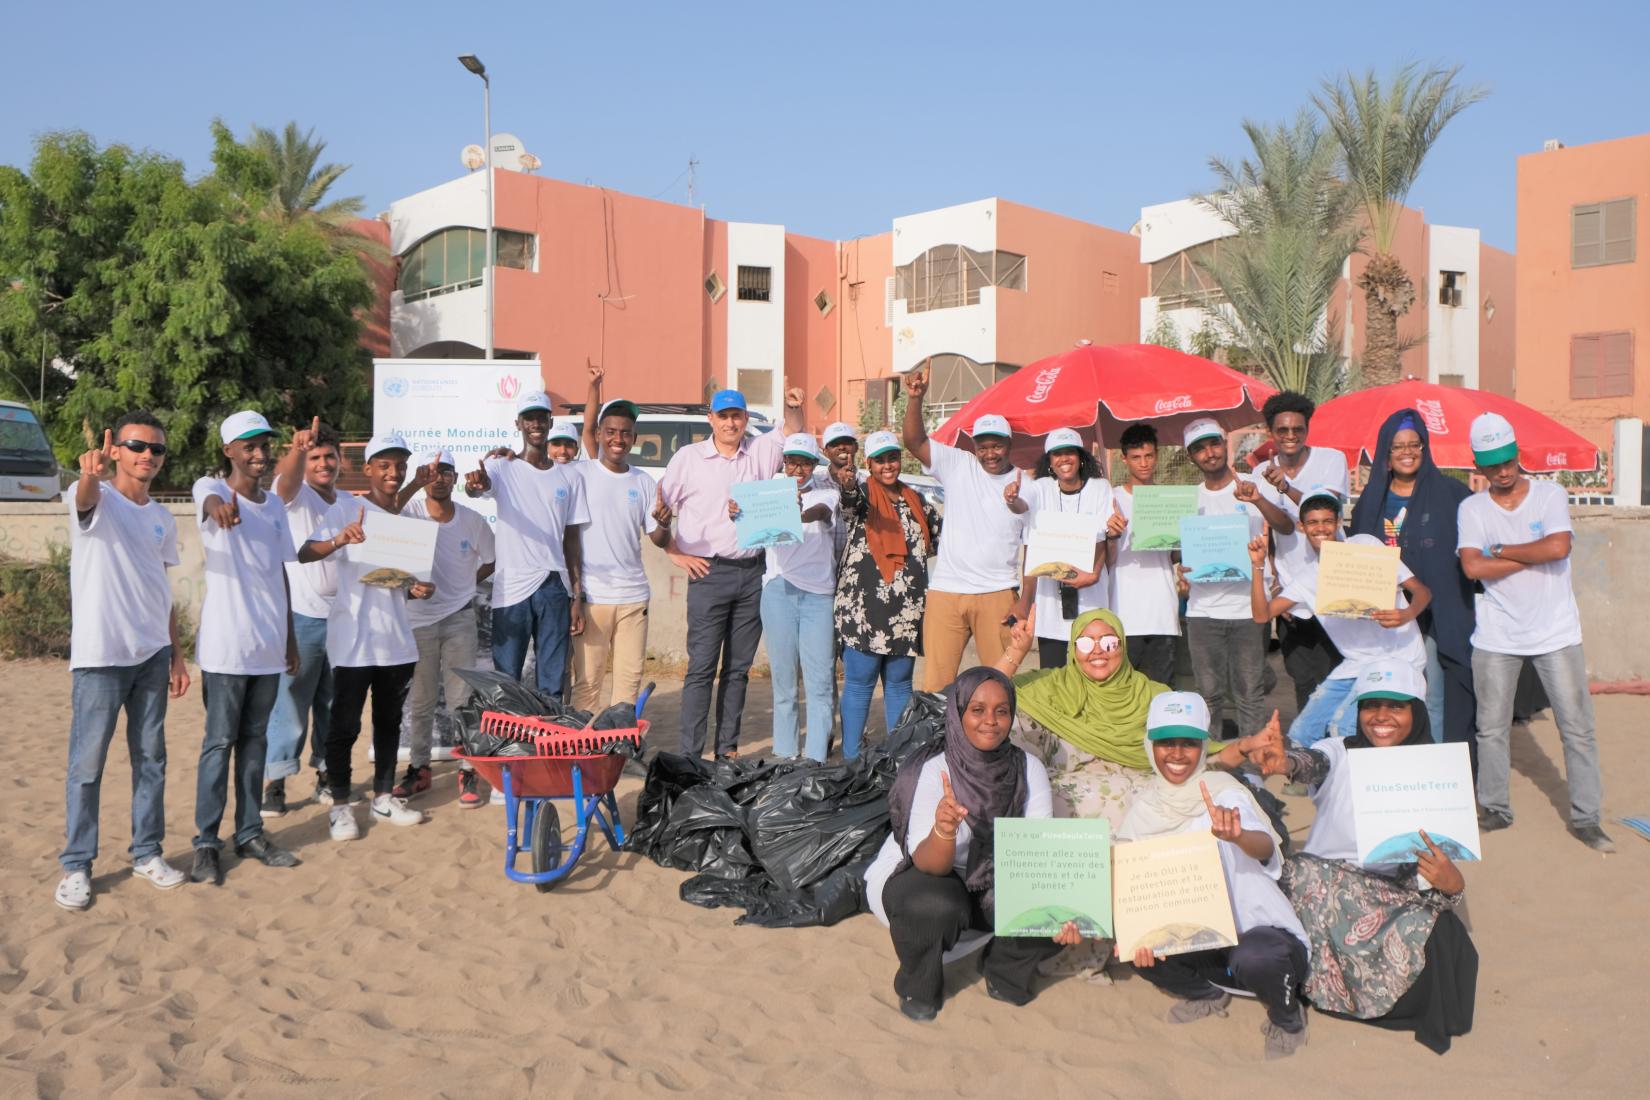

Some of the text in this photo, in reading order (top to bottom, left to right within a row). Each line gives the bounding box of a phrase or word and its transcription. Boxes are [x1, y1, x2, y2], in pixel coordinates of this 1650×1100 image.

[1155, 395, 1192, 413] Coca-Cola
[390, 427, 441, 438] Journée
[447, 427, 508, 438] Mondiale
[1365, 781, 1458, 793] #UneSeuleTerre
[1005, 849, 1100, 858] Comment allez vous
[1000, 859, 1105, 869] influencer l'avenir des
[1009, 871, 1058, 880] personnes
[1073, 871, 1085, 880] de
[1144, 871, 1158, 879] dis
[1161, 866, 1178, 876] OUI
[1130, 879, 1178, 893] protection
[1182, 875, 1190, 883] et
[1118, 883, 1218, 904] restauration de notre
[1126, 903, 1160, 914] maison
[1163, 895, 1209, 908] commune
